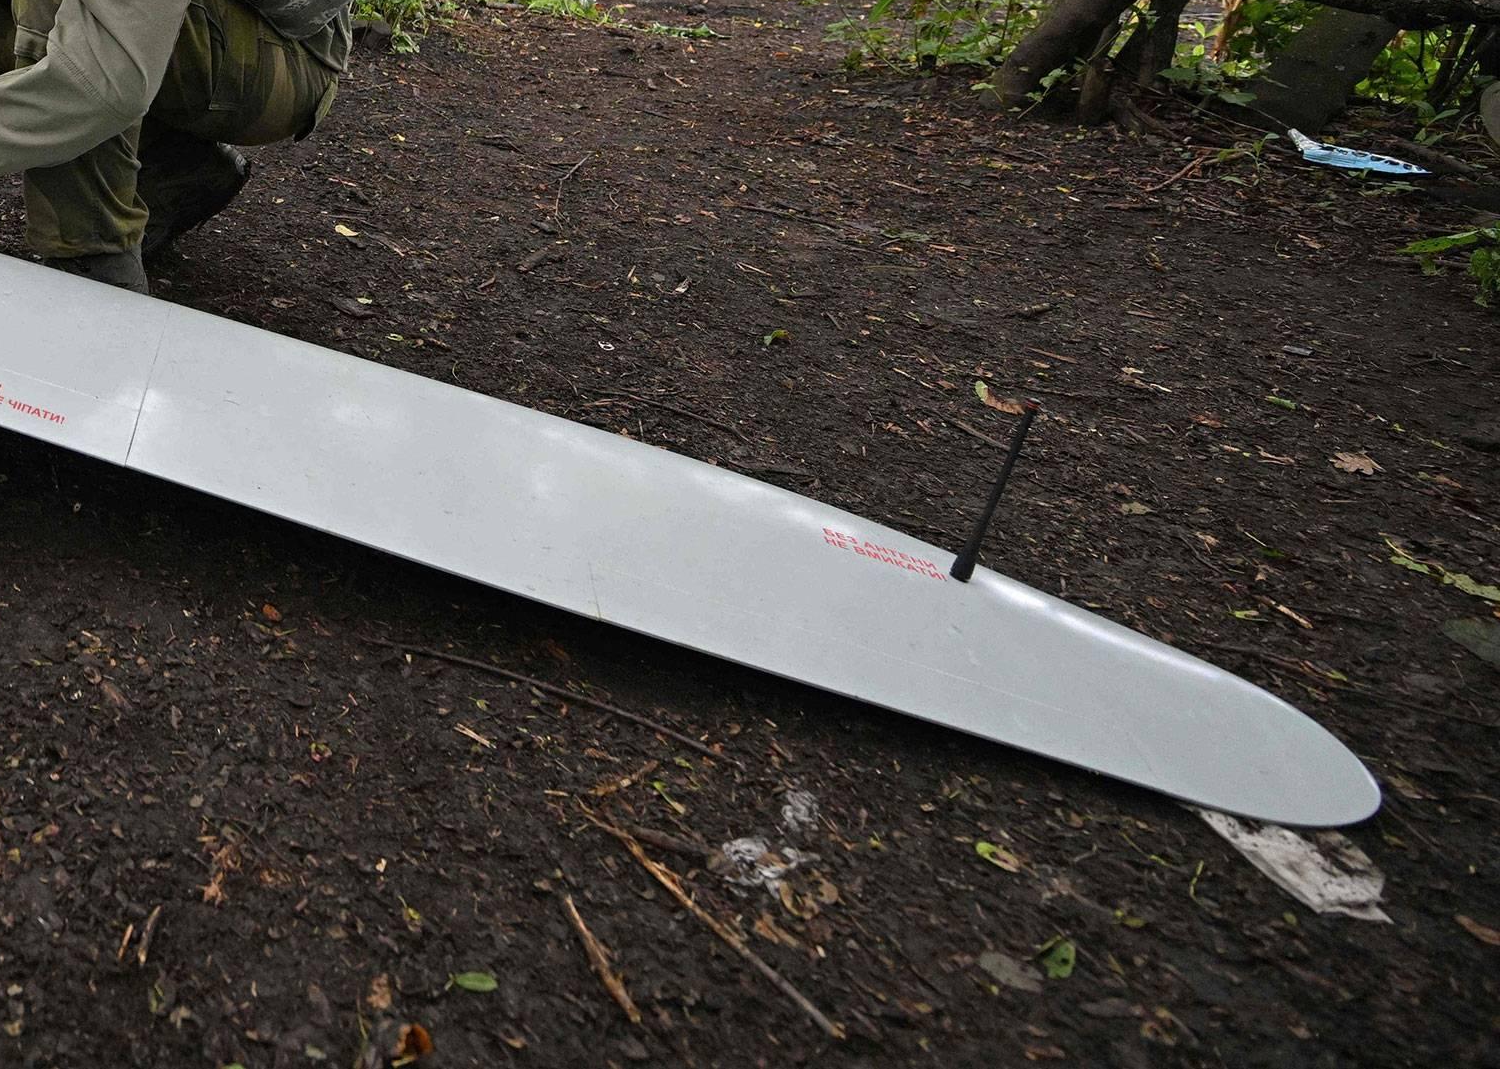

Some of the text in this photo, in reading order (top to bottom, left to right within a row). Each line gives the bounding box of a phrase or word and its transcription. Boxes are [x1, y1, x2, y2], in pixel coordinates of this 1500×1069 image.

[8, 399, 66, 425] ЧІПАТИ!
[822, 527, 858, 545] БЕЗ
[823, 536, 850, 551] НЕ
